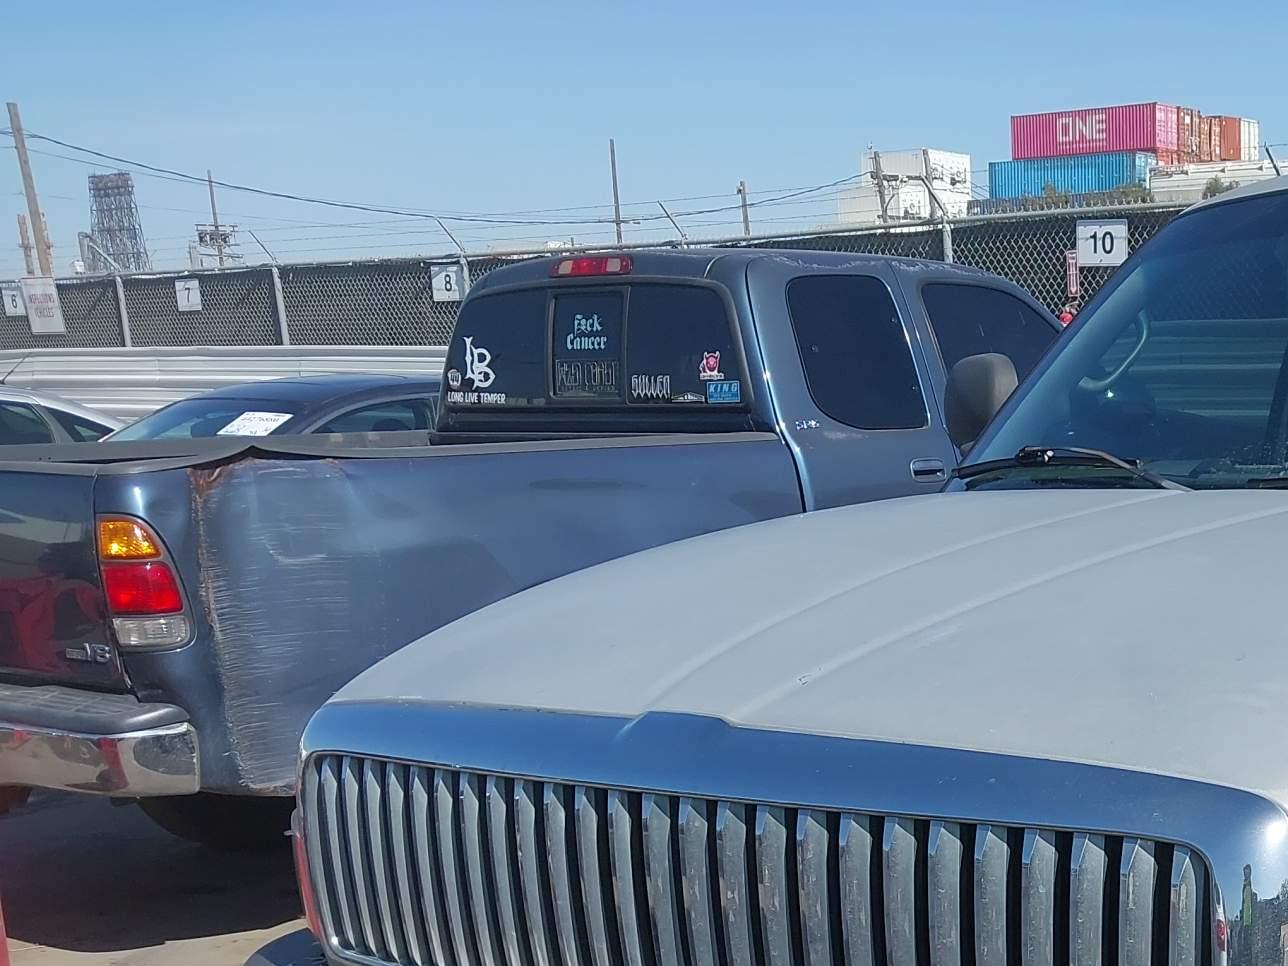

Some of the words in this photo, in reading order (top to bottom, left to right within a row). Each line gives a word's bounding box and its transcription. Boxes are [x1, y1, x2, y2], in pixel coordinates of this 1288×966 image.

[1056, 112, 1107, 143] ONE
[1089, 231, 1114, 254] 10
[444, 273, 453, 292] 8
[11, 294, 18, 309] 6
[184, 287, 191, 304] 7
[566, 333, 608, 350] Cancer
[709, 382, 738, 394] KING
[447, 391, 464, 402] LONG
[464, 391, 479, 403] LIVE
[480, 392, 506, 404] TEMPER
